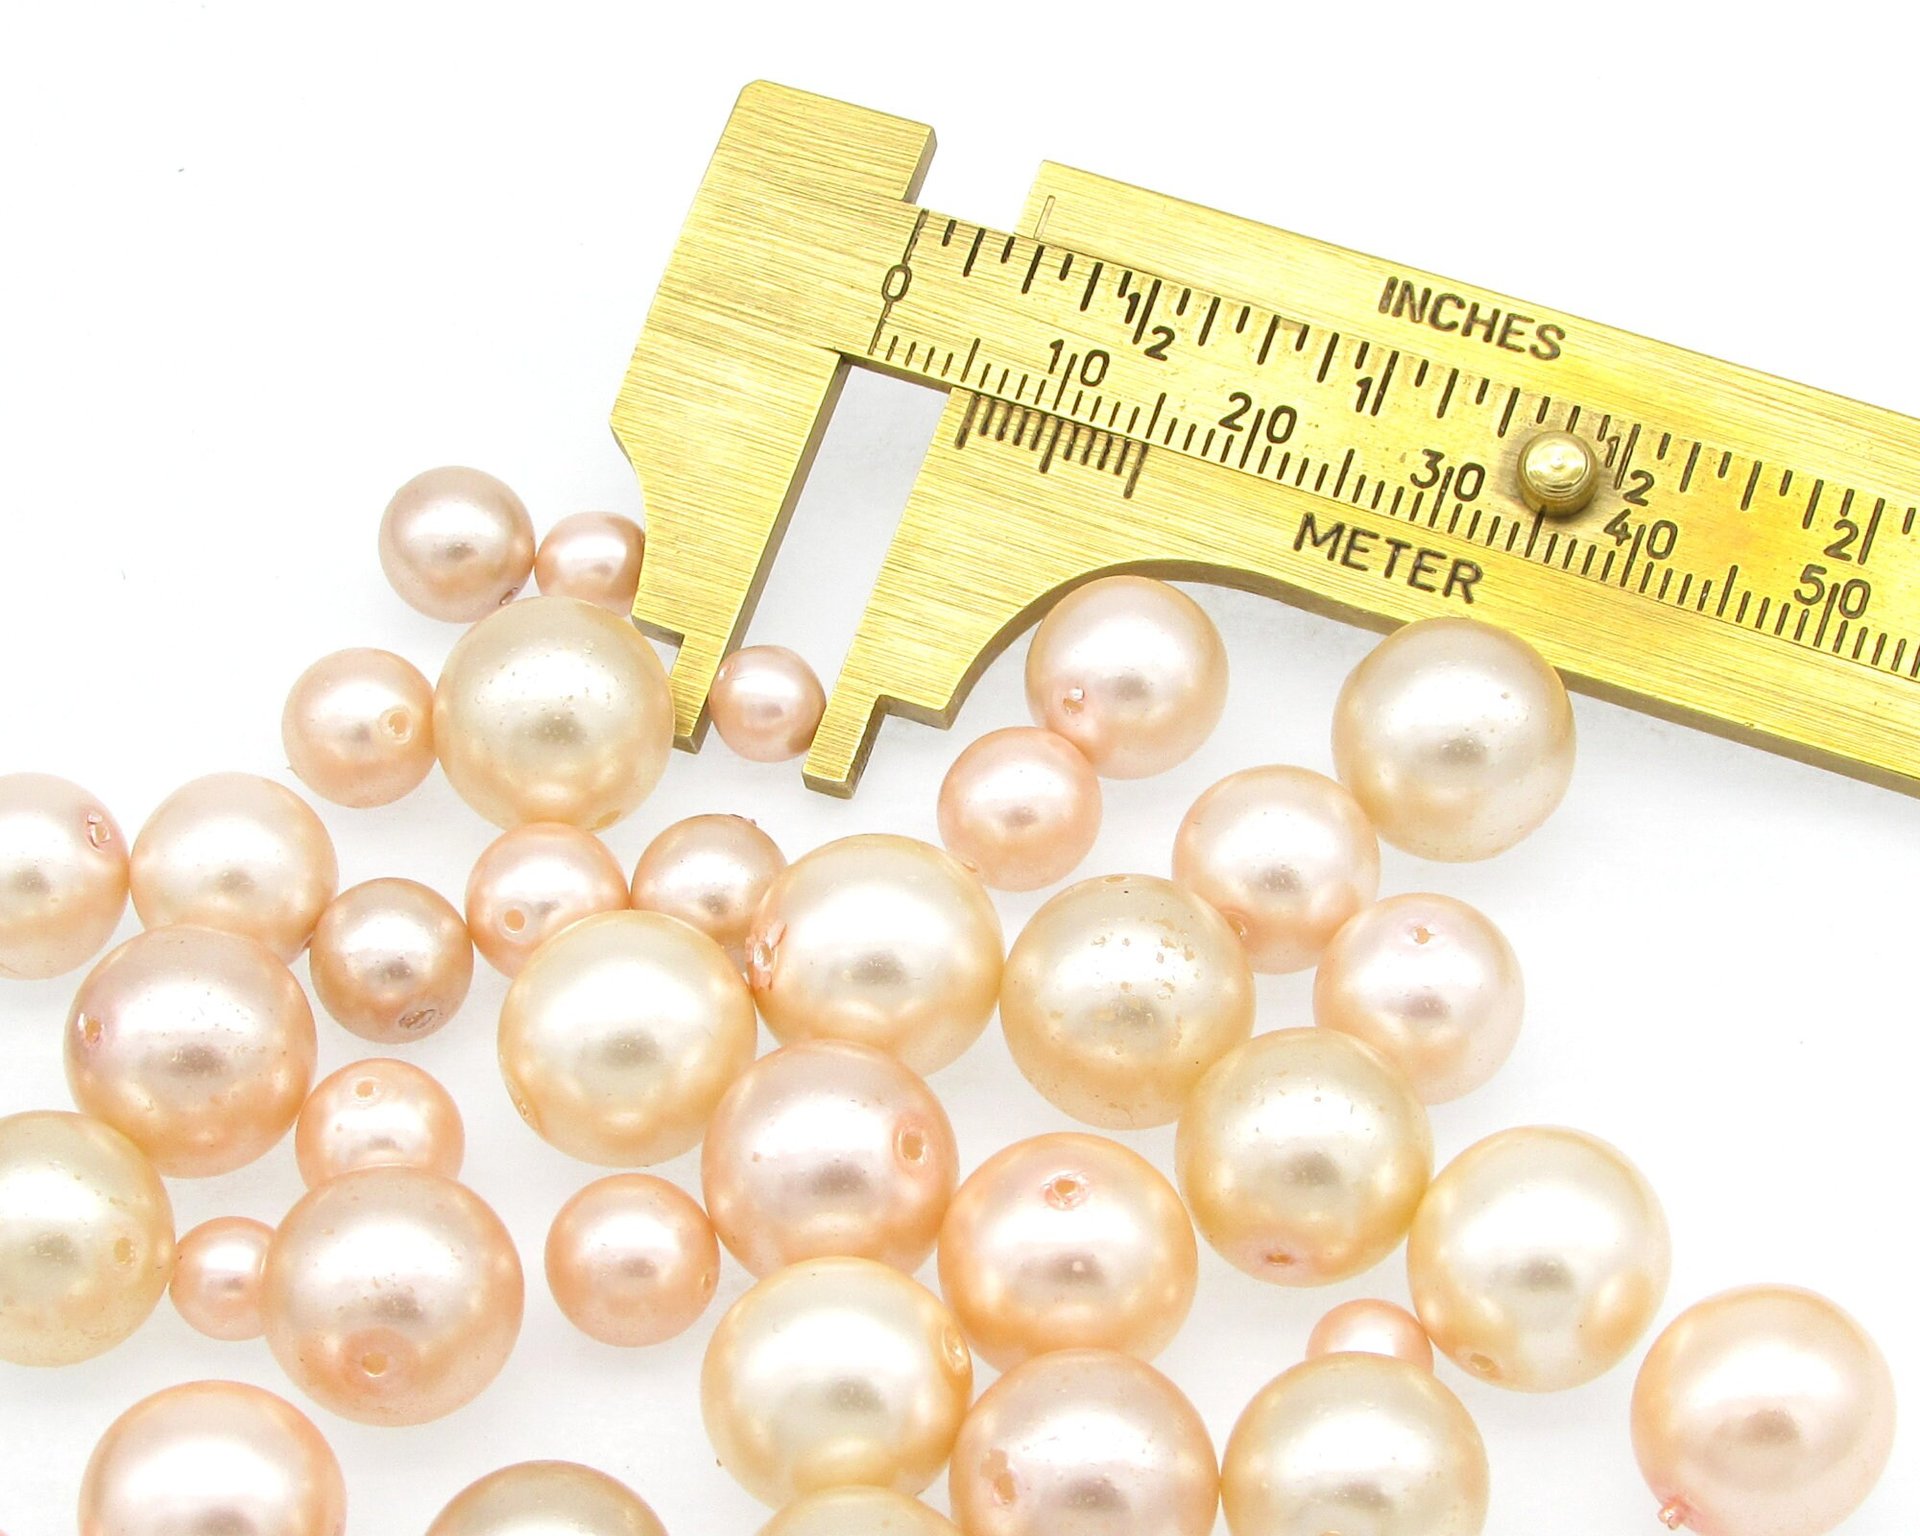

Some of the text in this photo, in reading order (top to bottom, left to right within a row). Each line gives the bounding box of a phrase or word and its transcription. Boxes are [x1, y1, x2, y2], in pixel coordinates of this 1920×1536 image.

[882, 264, 912, 302] 0
[1378, 276, 1567, 362] INCHES
[1049, 338, 1110, 387] 10
[1218, 391, 1298, 444] 20
[1355, 375, 1374, 413] 1
[1410, 448, 1486, 502] 30
[1292, 511, 1484, 605] METER
[1603, 508, 1678, 560] 40
[1823, 518, 1859, 562] 2
[1793, 563, 1871, 619] 50
